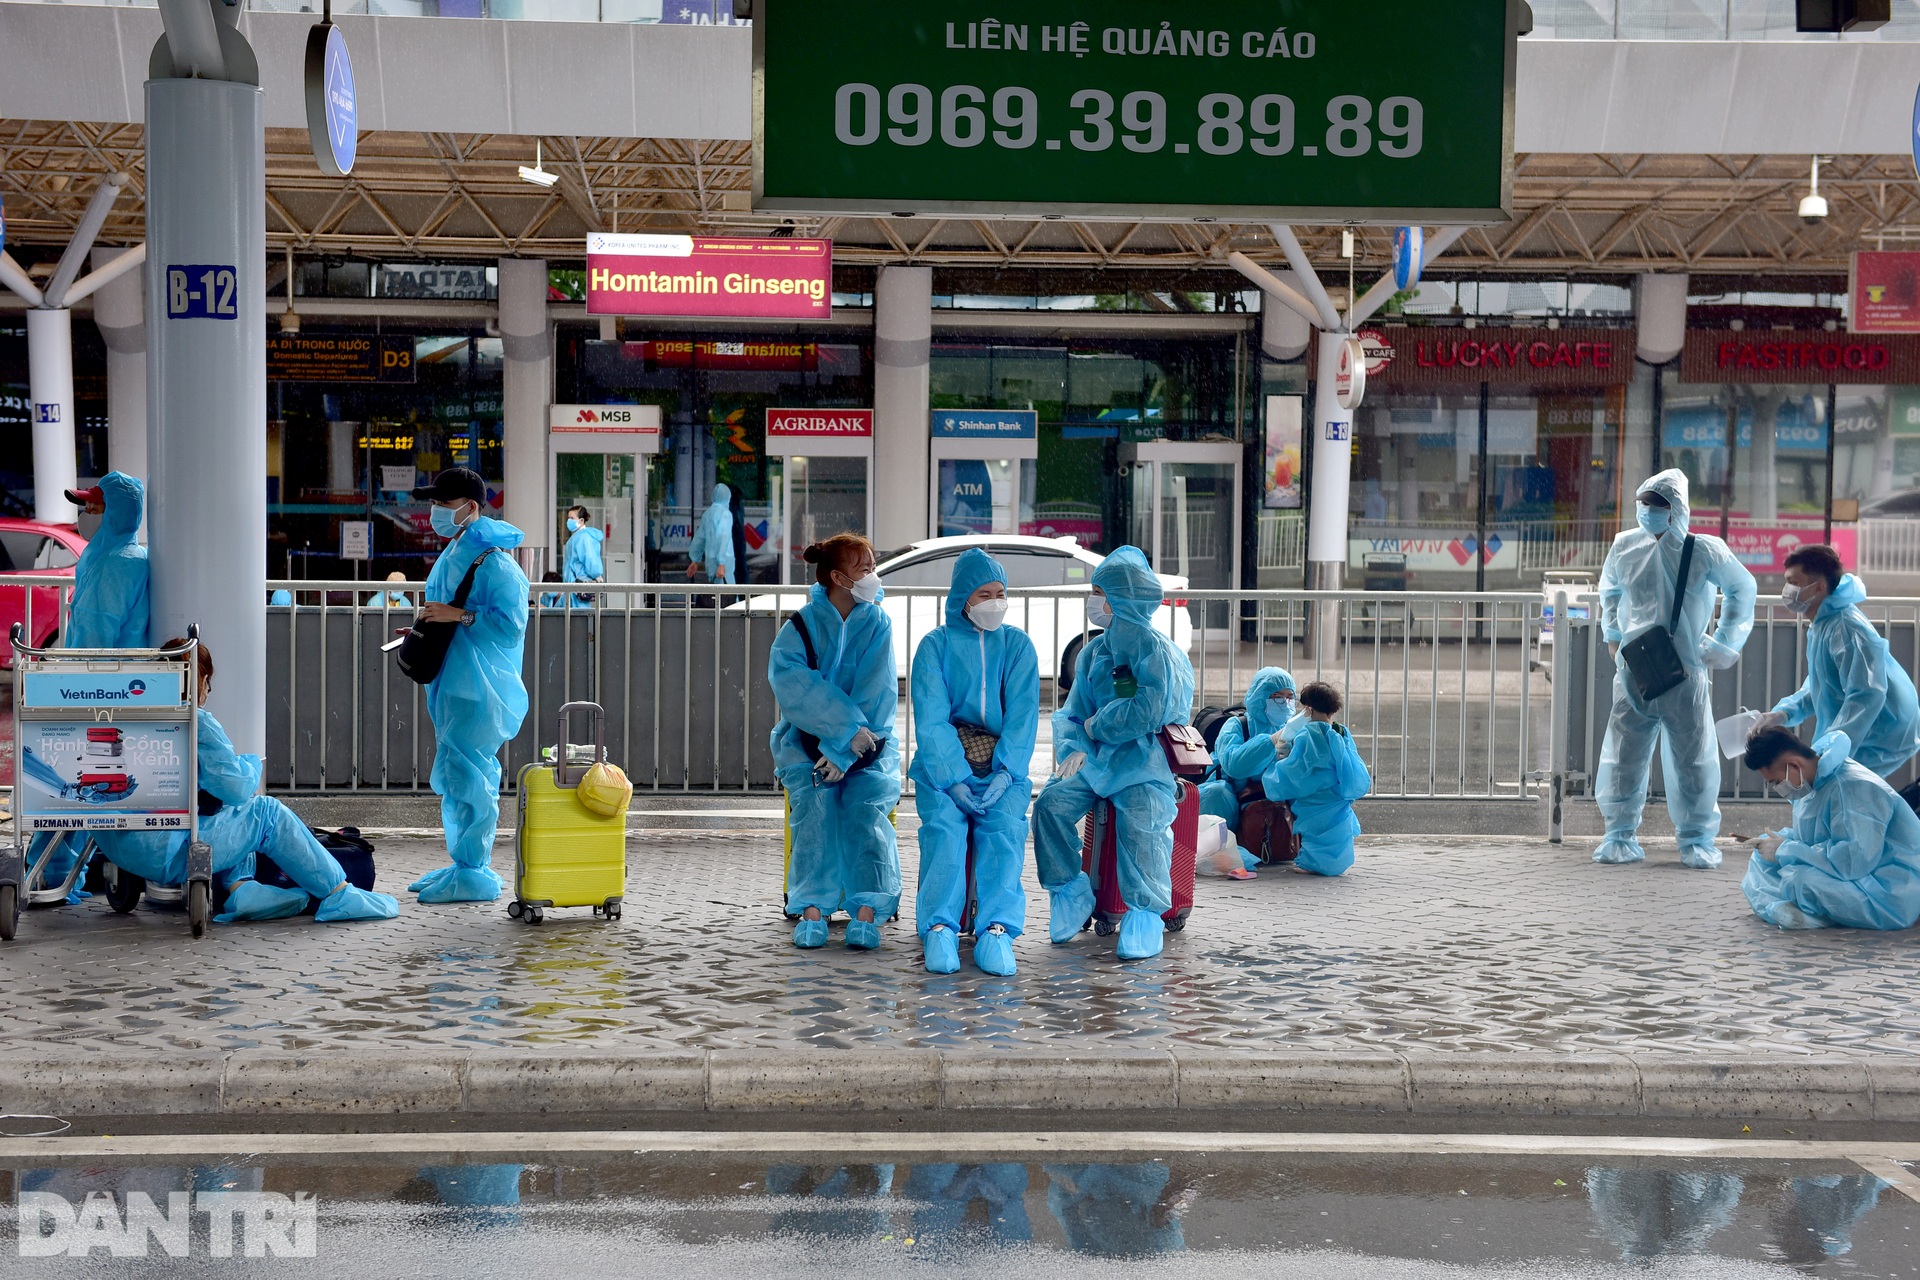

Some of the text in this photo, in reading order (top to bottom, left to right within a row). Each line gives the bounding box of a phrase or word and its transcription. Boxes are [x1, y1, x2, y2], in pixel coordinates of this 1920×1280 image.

[946, 17, 1316, 59] LIÊN HỆ QUẢNG CÁO
[834, 82, 1424, 158] 0969.39.89.89
[591, 268, 825, 299] Homtamin Ginseng
[170, 270, 235, 314] B-12
[296, 340, 335, 350] TRONG
[338, 339, 370, 350] NƯỚC
[314, 352, 358, 360] Departures
[384, 351, 410, 367] D3
[1373, 350, 1396, 358] CAFE
[1417, 341, 1611, 368] LUCKY CAFE
[1719, 343, 1889, 370] FASTFOOD
[36, 405, 60, 422] A-14
[601, 411, 631, 422] MSB
[772, 418, 864, 431] AGRIBANK
[959, 421, 1021, 431] Shinhan Bank
[1326, 423, 1348, 439] A-13
[953, 483, 983, 496] ATM
[60, 689, 130, 699] VietinBank
[123, 735, 173, 754] Cồng
[132, 751, 180, 766] Kềnh
[34, 819, 84, 828] BIZMAN.VN
[145, 818, 180, 826] SG 1353
